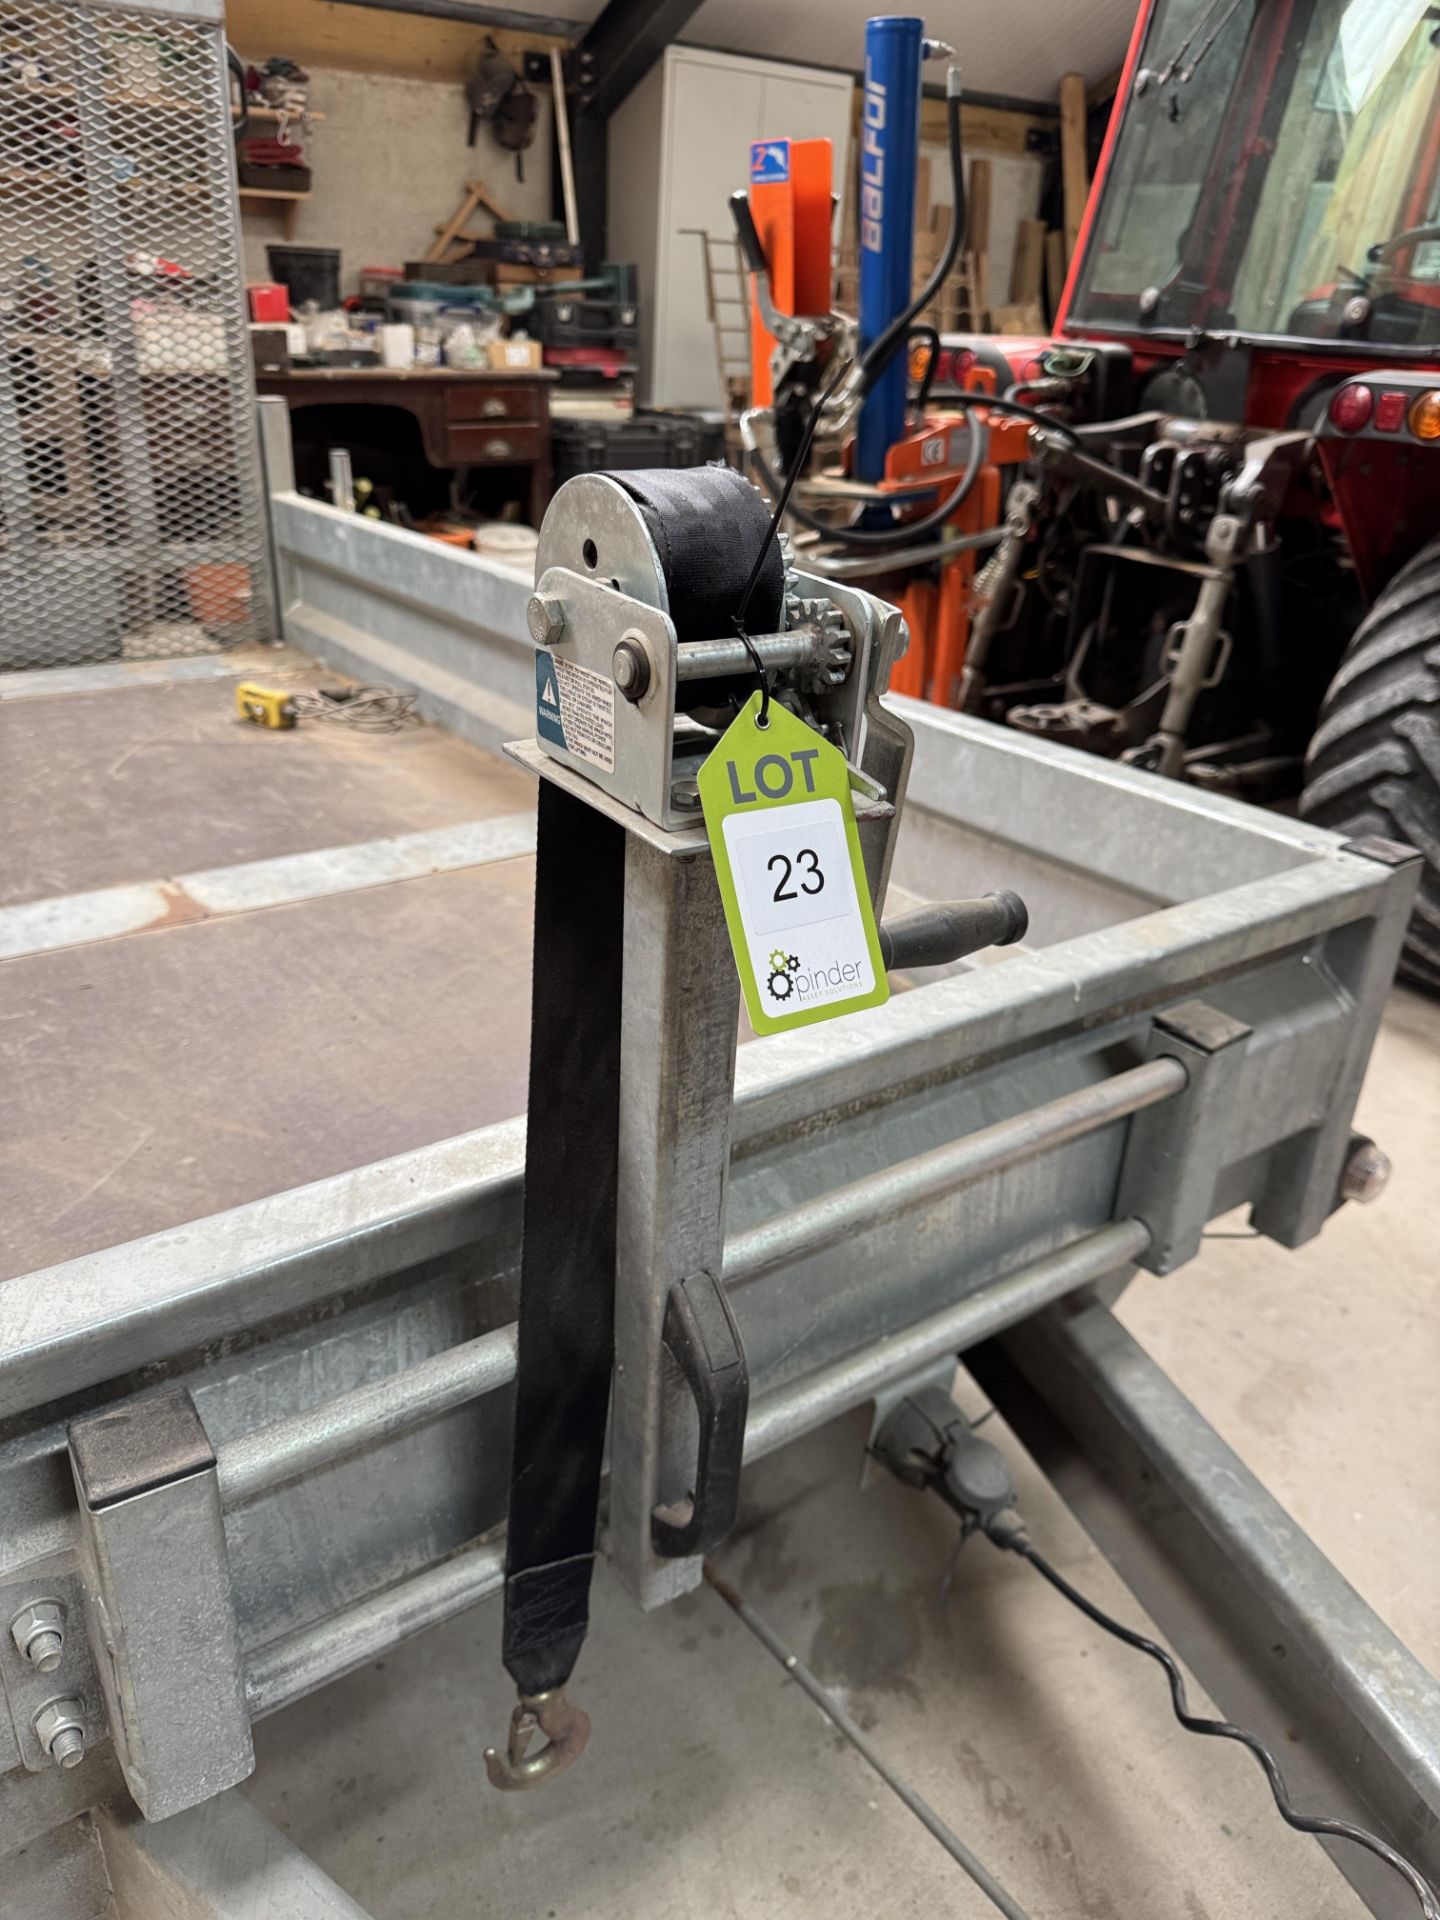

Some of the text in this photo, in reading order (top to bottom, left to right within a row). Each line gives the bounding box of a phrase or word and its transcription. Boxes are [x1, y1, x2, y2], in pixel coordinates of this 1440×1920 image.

[538, 705, 561, 725] WARNING
[727, 748, 819, 804] LOT
[767, 848, 825, 902] 23
[795, 960, 862, 1002] pinder
